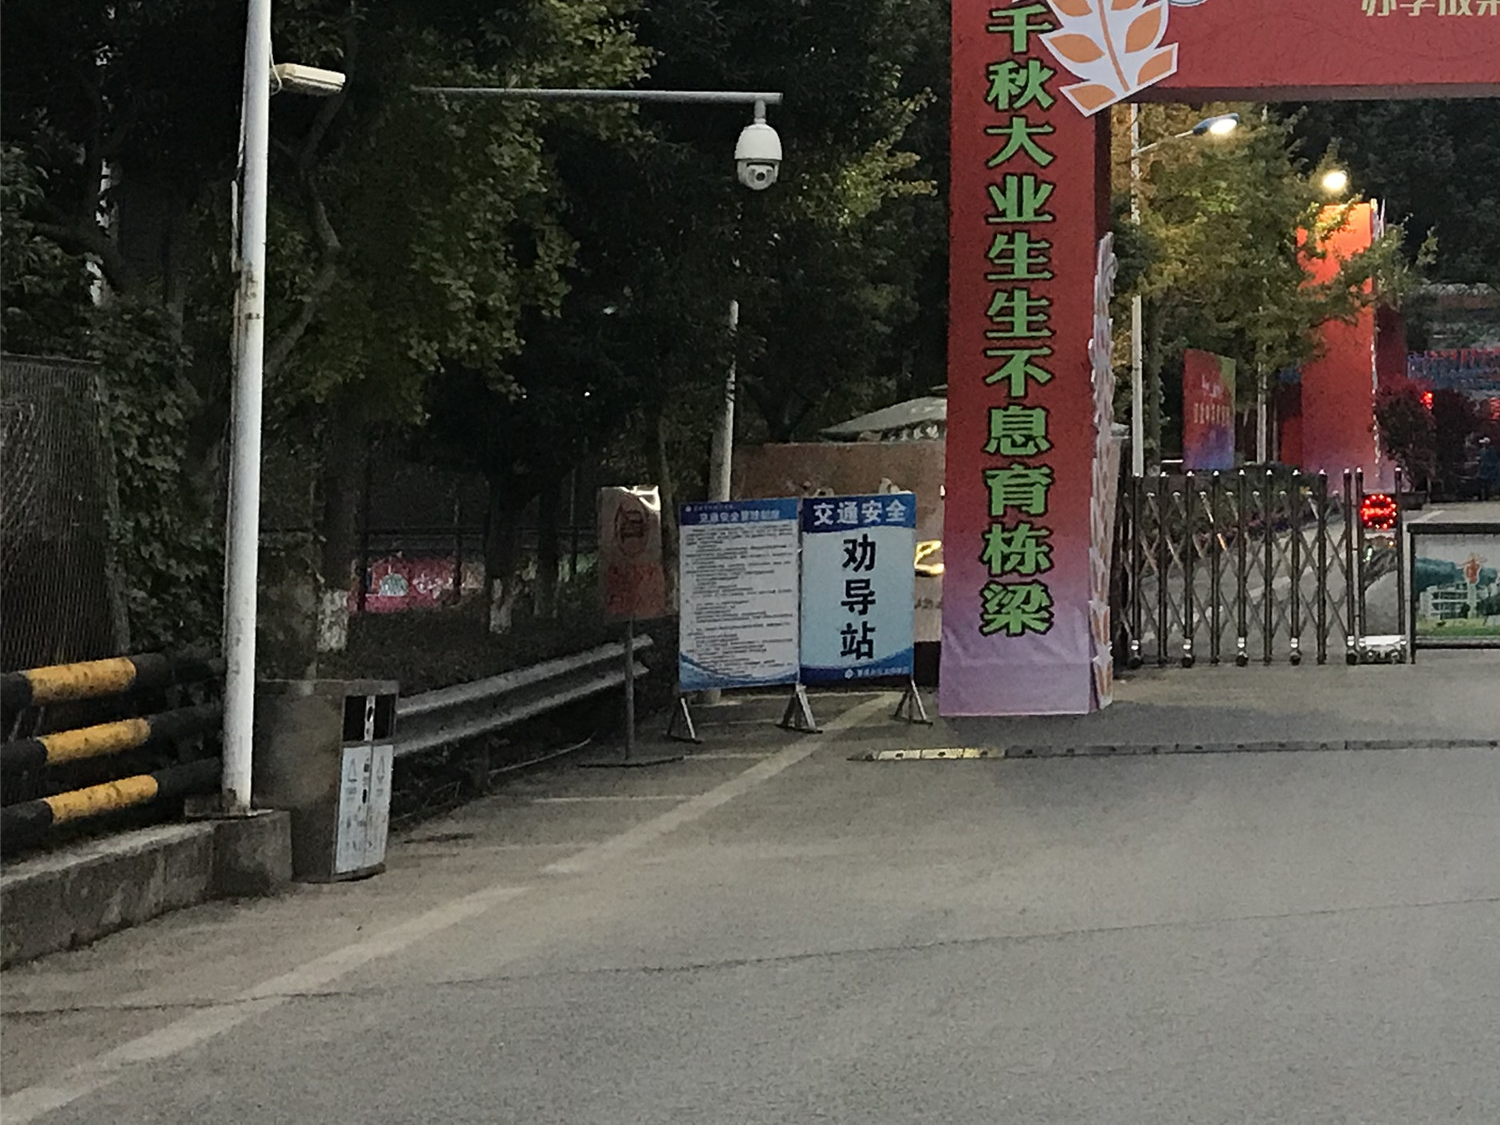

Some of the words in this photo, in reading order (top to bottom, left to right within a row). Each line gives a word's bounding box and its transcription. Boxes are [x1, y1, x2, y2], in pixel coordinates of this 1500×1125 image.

[982, 2, 1055, 637] 千秋大业生生不息育栋梁
[812, 499, 907, 525] 交通安全
[840, 533, 877, 660] 劝导站
